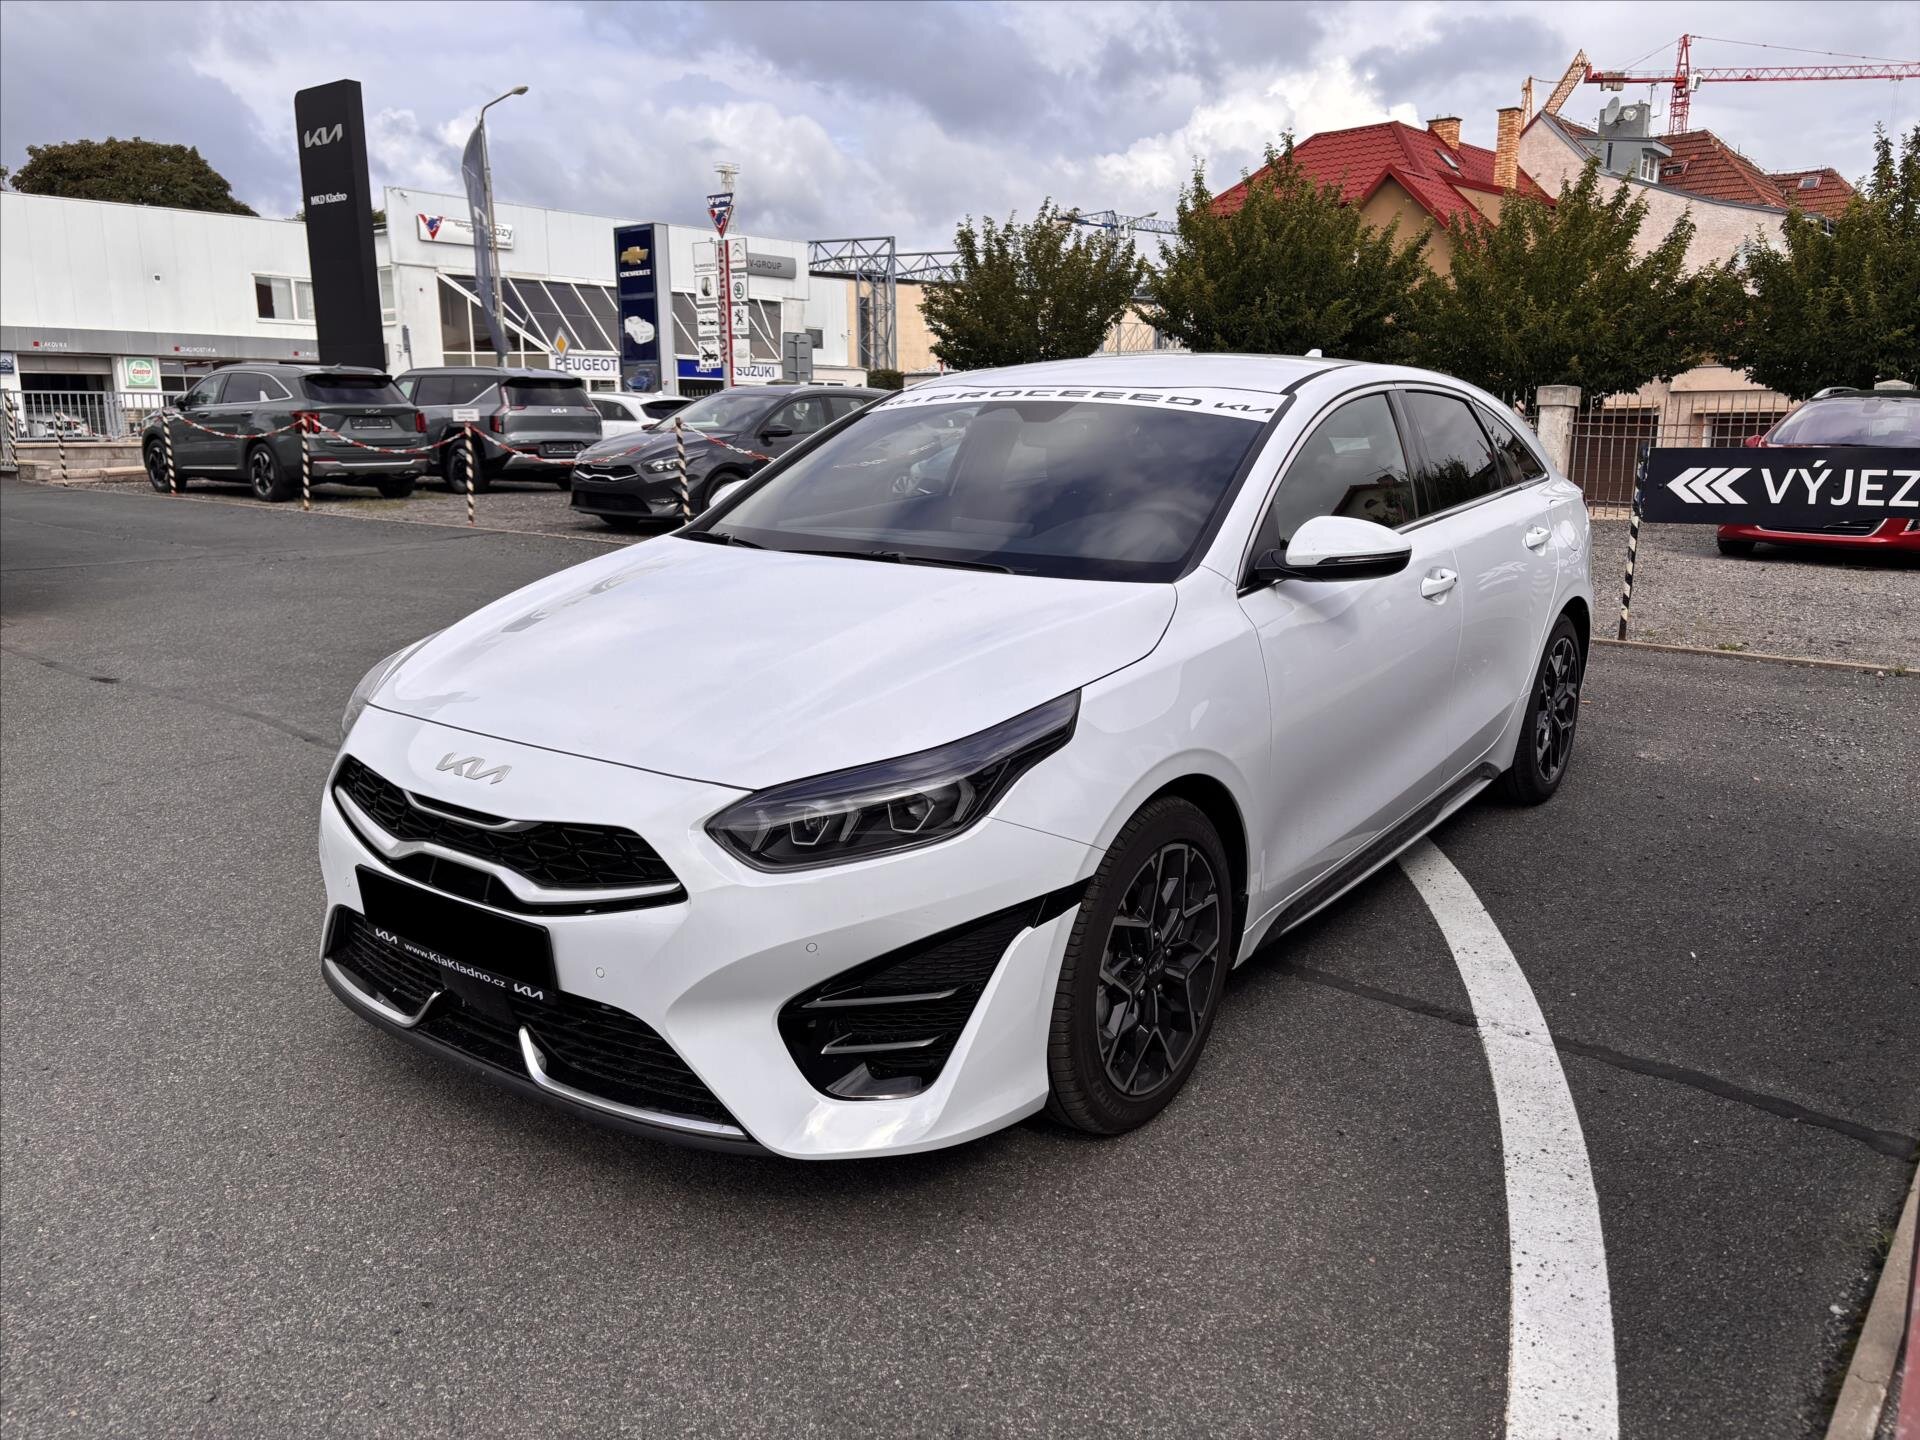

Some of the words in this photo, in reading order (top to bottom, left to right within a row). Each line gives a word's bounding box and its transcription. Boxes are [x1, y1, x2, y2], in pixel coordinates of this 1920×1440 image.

[304, 123, 343, 148] KIA
[749, 258, 782, 270] V-GROUP
[555, 357, 618, 372] PEUGEOT
[736, 365, 776, 377] SUZUKI
[1213, 402, 1275, 414] KIA
[1760, 459, 1920, 507] VÝJEZ
[435, 751, 513, 785] KIA
[375, 928, 398, 944] KIA
[404, 943, 507, 988] www.KiaKladno.cz
[513, 983, 544, 1000] KIA
